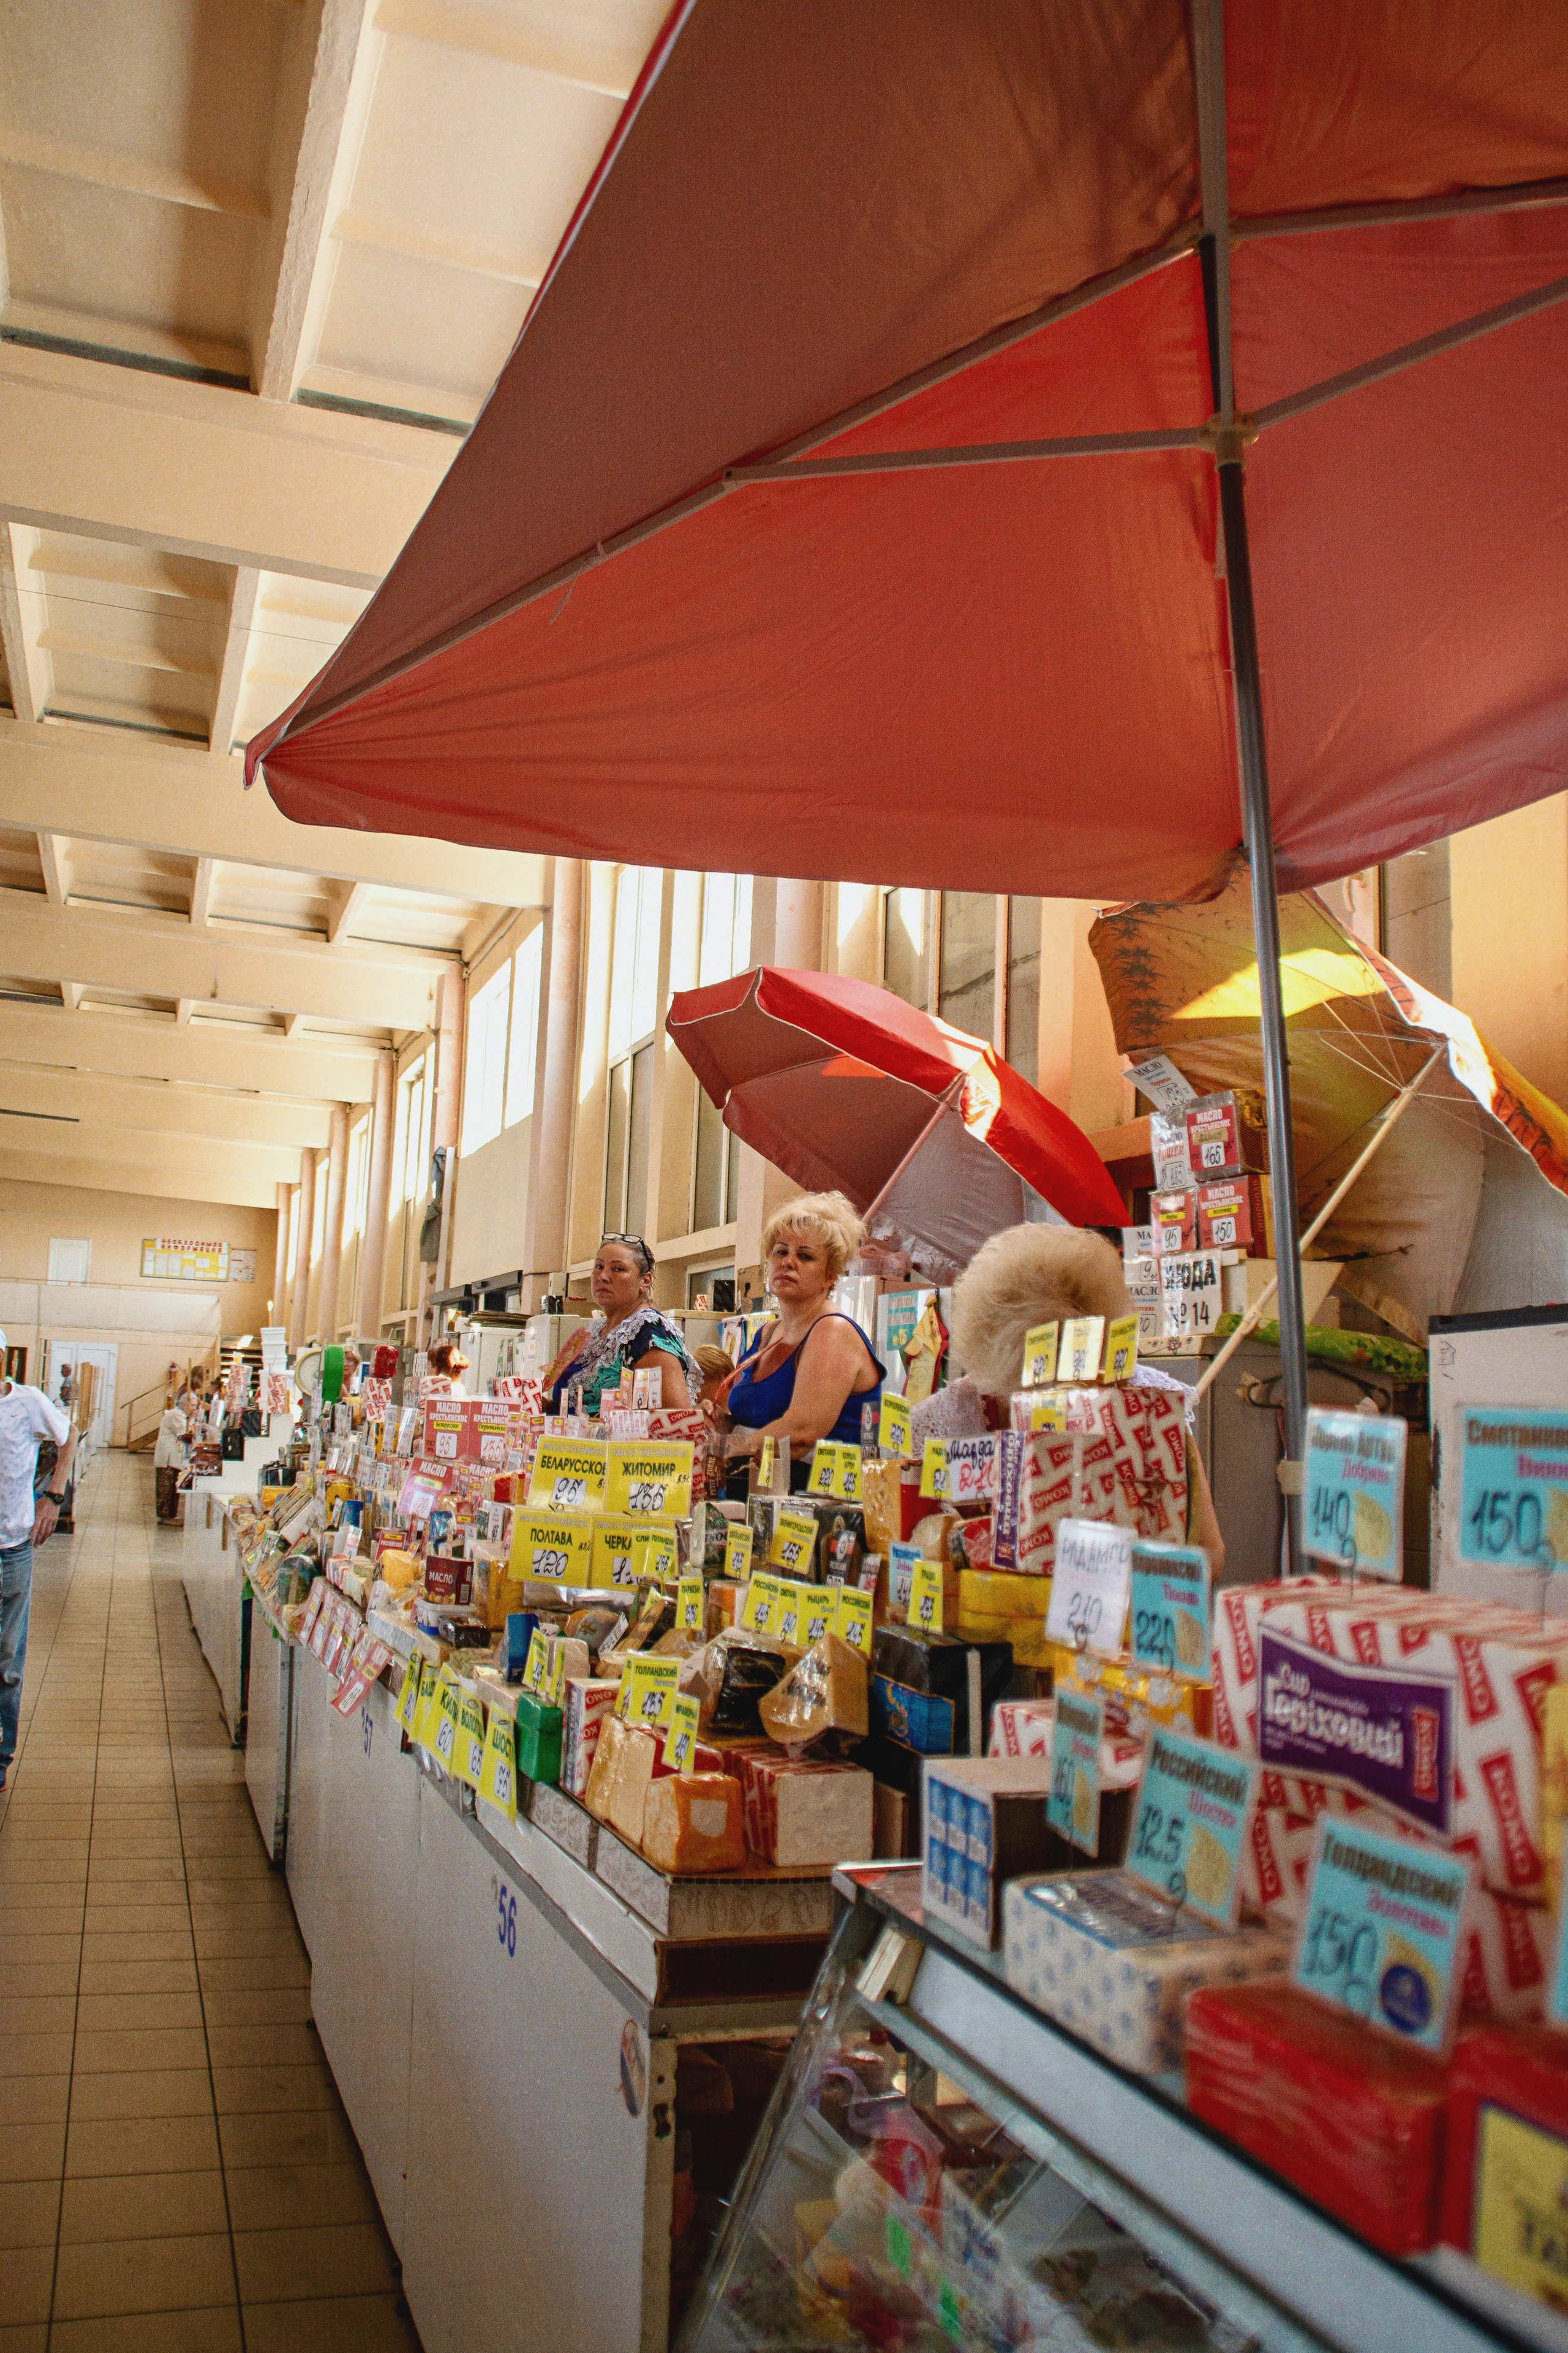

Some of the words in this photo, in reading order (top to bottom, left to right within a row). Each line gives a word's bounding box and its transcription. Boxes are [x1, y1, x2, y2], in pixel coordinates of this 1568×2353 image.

[1134, 1062, 1163, 1078] МАСЛО
[1197, 1109, 1223, 1124] МАСЛО
[1204, 1145, 1222, 1167] 165
[1207, 1185, 1235, 1200] МАСЛО
[1165, 1228, 1178, 1248] 95
[1215, 1221, 1233, 1244] 150
[1192, 1301, 1210, 1327] 14
[436, 1402, 462, 1414] МАСЛО
[481, 1403, 509, 1416] МАСЛО
[429, 1413, 468, 1422] КРЕСТЬЯНСКОЕ
[439, 1435, 452, 1456] 95
[543, 1442, 566, 1452] МАСЛО
[567, 1444, 606, 1457] КРЕСТЬЯНСКО
[613, 1448, 637, 1457] МАСЛО
[639, 1448, 687, 1458] КРЕСТЬЯНСКОЕ
[419, 1460, 448, 1478] МАСЛО
[622, 1462, 676, 1477] ЖИТОМИР
[555, 1478, 583, 1503] 95
[1470, 1487, 1543, 1557] 150
[529, 1528, 573, 1547] ПОЛТАВА
[532, 1550, 569, 1577] 120
[428, 1571, 454, 1585] МАСЛО
[635, 1665, 679, 1678] ГОЛЛАНДСКИЙ
[437, 1722, 453, 1753] 60
[498, 1884, 518, 1958] 56
[1305, 1905, 1379, 1977] 150
